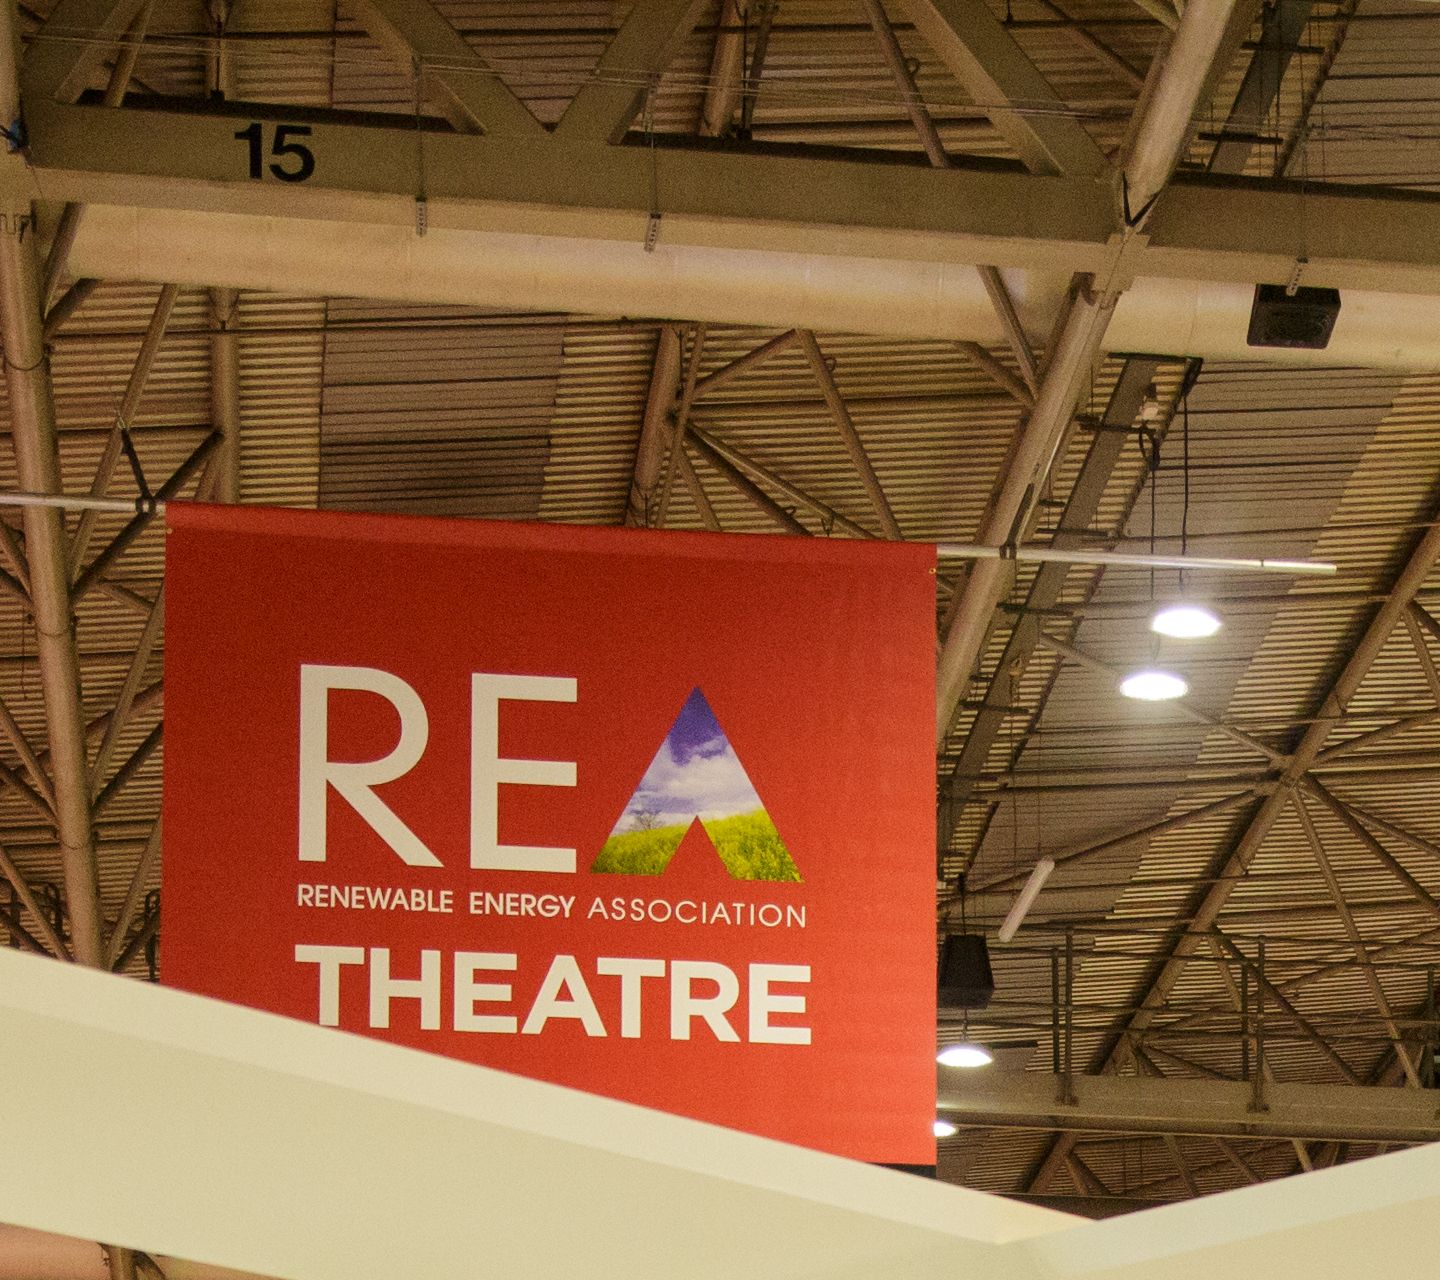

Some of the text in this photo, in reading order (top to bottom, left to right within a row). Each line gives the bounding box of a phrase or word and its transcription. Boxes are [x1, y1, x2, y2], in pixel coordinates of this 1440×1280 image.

[234, 123, 315, 182] 15
[298, 664, 804, 883] REA
[297, 883, 807, 928] RENEWABLE ENERGY ASSOCIATION
[295, 944, 812, 1046] THEATRE
